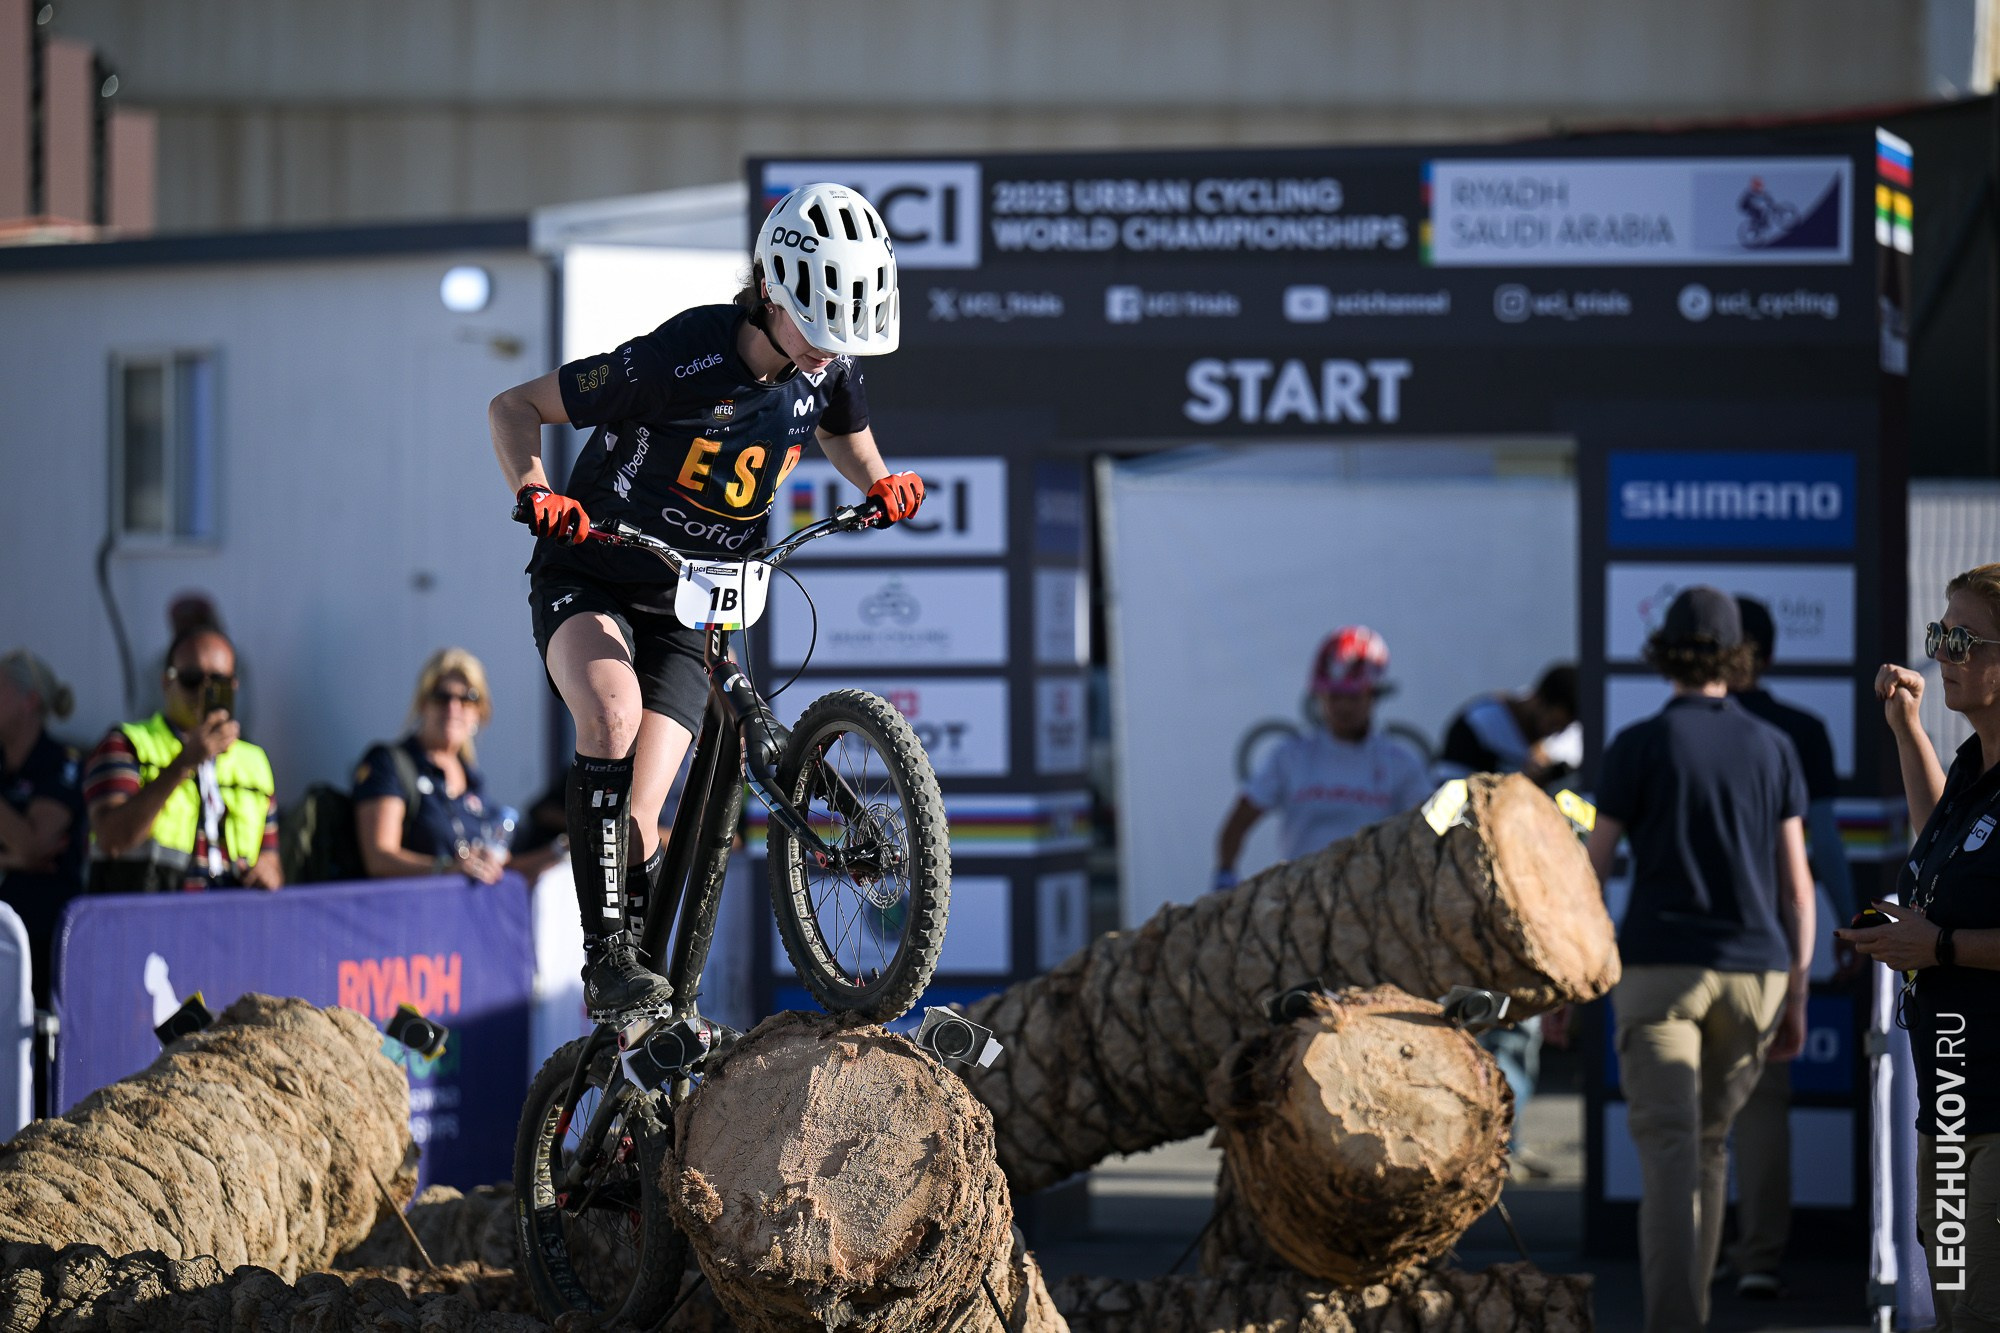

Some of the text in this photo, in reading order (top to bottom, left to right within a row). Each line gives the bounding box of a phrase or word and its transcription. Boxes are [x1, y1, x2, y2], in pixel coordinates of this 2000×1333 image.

[993, 179, 1342, 214] 2025 URBAN CYCLING
[1450, 176, 1569, 210] RIYADH
[848, 183, 957, 246] CI
[1450, 212, 1676, 248] SAUDI ARABIA
[991, 215, 1408, 251] WORLD CHAMPIONSHIPS
[576, 364, 609, 393] ESP
[674, 352, 724, 379] Cofidis
[1184, 358, 1411, 424] START
[1621, 481, 1842, 520] SHIMANO
[709, 586, 739, 611] 1B
[338, 952, 462, 1022] RIYADH
